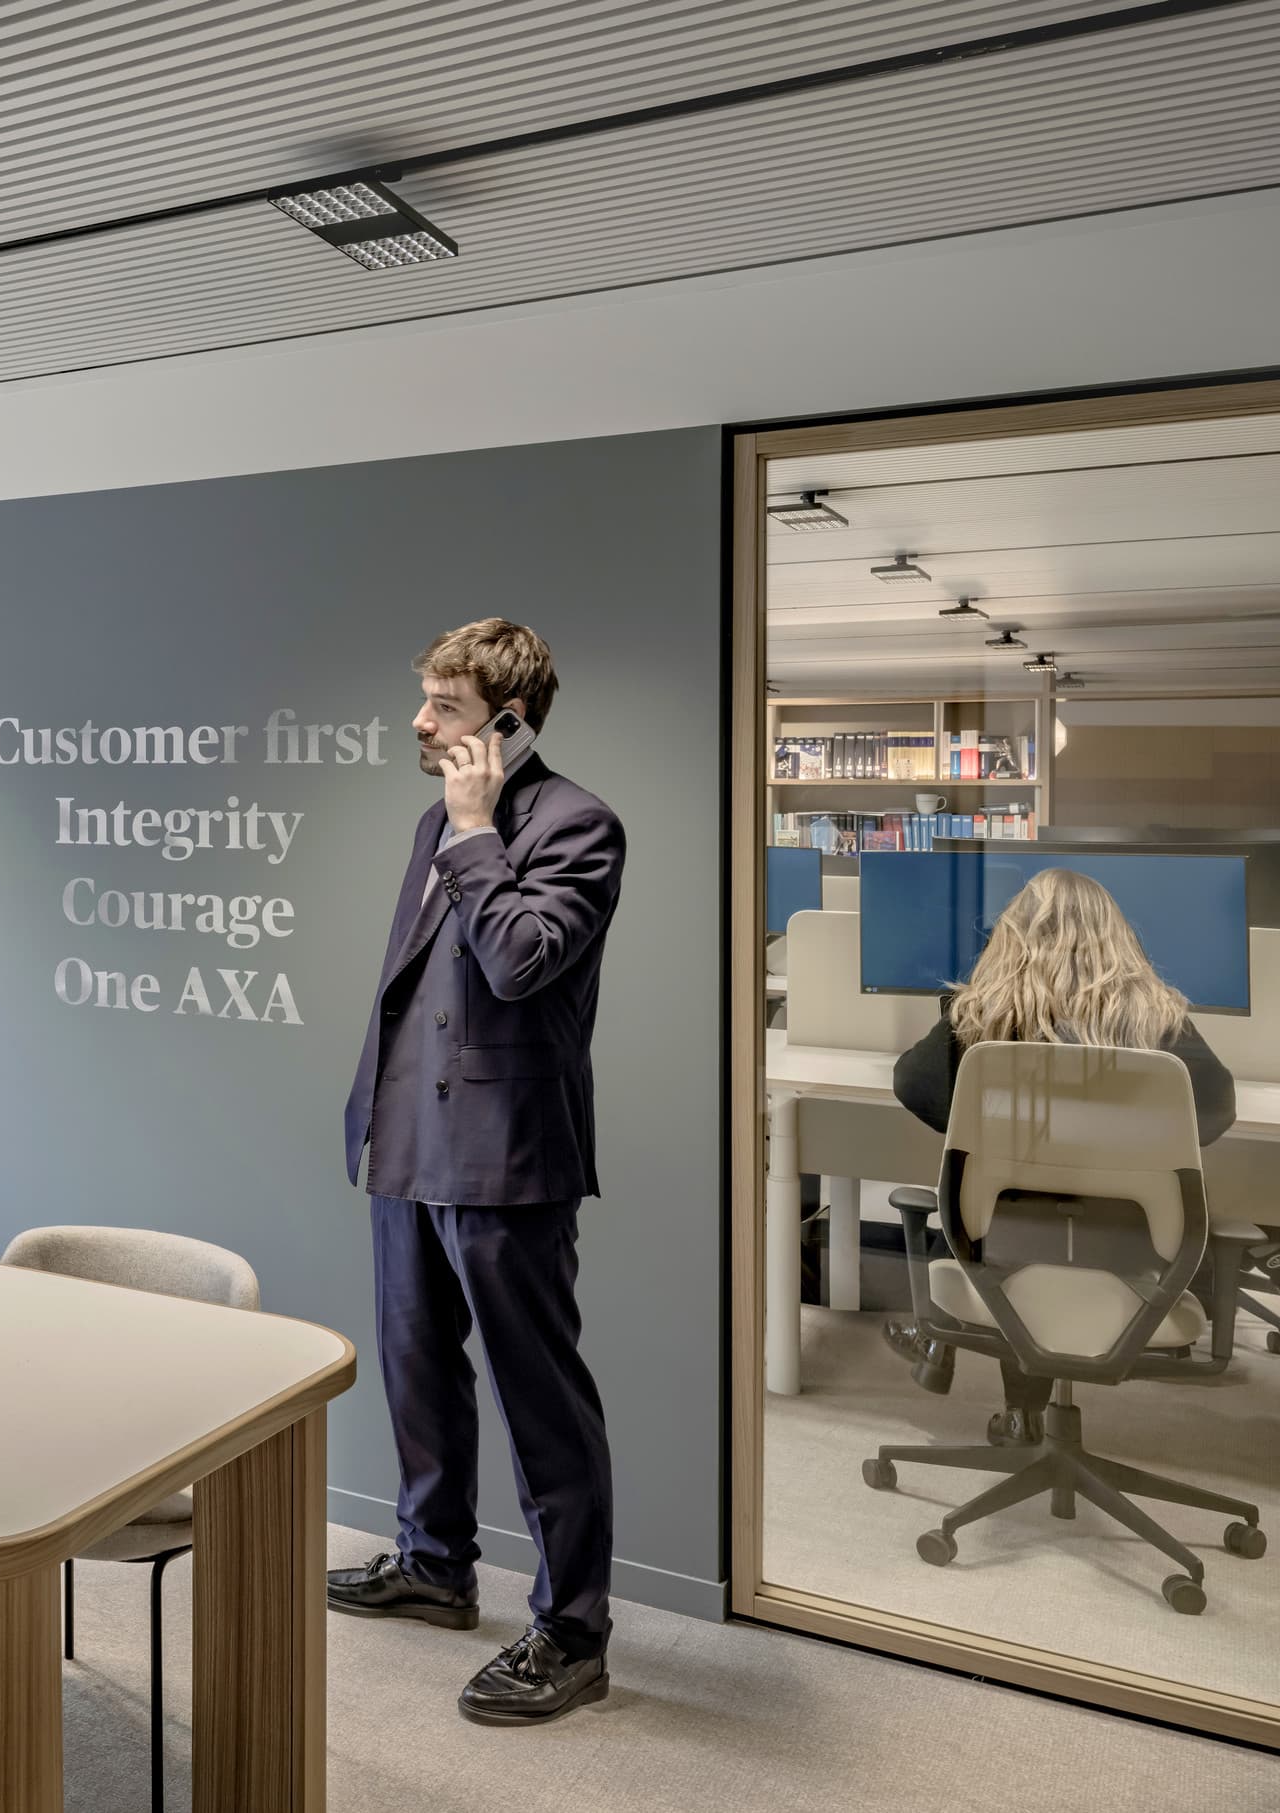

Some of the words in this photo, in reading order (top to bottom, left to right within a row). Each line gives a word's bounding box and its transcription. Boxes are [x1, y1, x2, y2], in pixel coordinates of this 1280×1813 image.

[263, 708, 388, 766] first
[55, 796, 304, 864] Integrity
[62, 877, 295, 949] Courage
[54, 957, 160, 1012] One
[173, 966, 305, 1025] AXA
